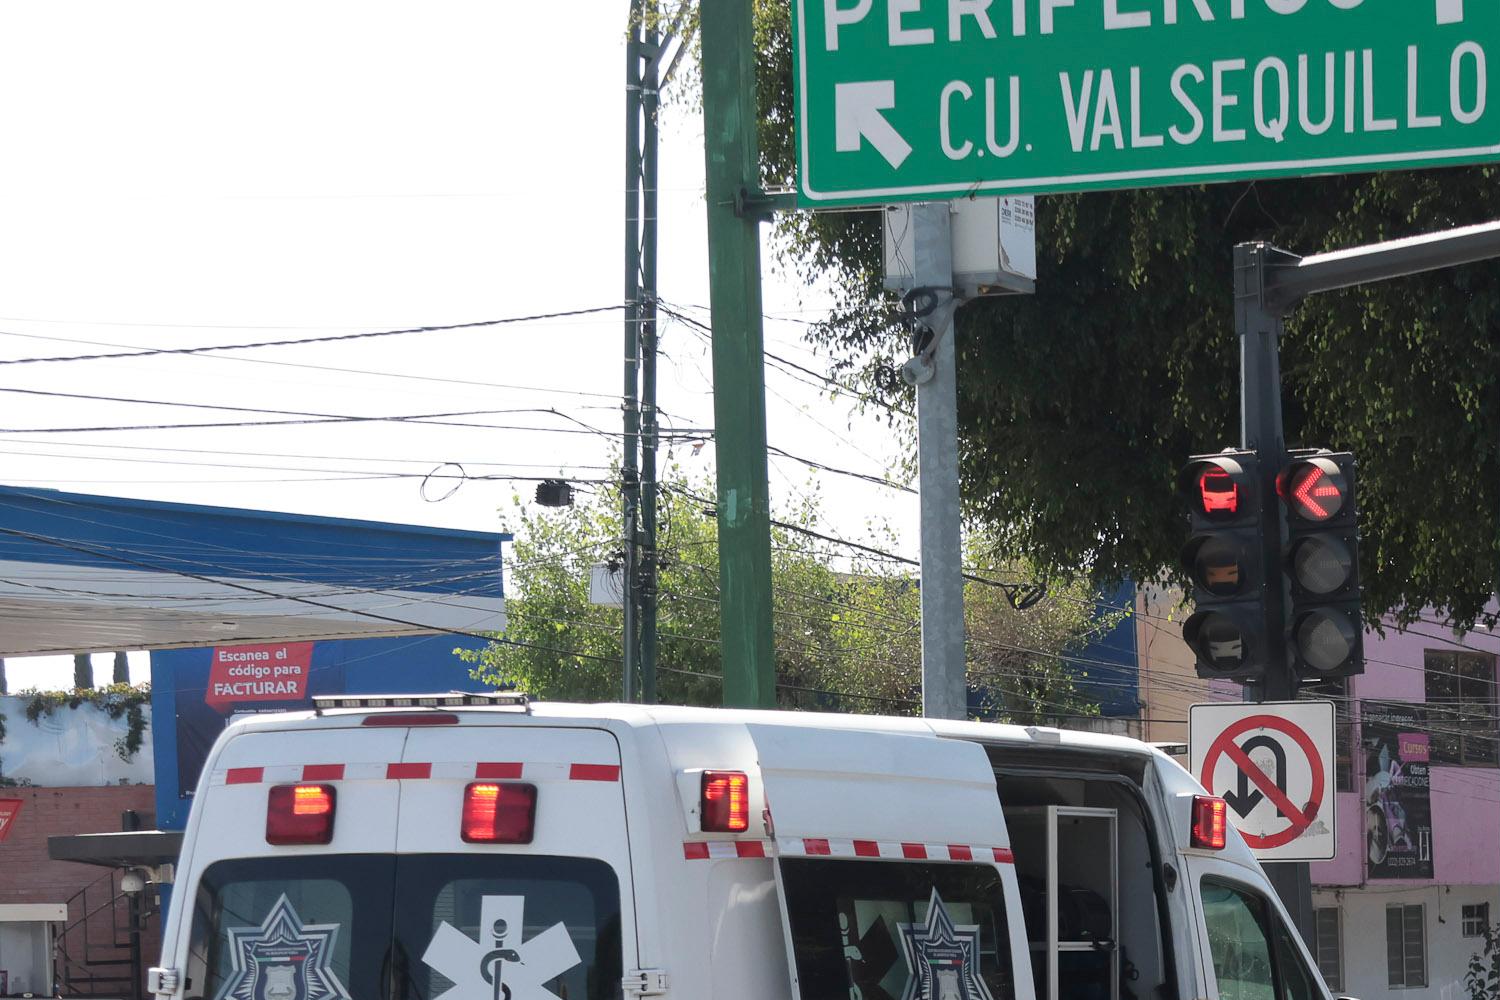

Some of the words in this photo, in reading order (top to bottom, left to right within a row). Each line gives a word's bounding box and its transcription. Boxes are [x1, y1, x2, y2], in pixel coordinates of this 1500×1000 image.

[940, 75, 1033, 160] C.U.
[1058, 40, 1487, 153] VALSEQUILLO
[219, 650, 270, 662] Escanea
[275, 648, 287, 660] el
[228, 665, 271, 679] código
[274, 665, 301, 677] para
[214, 680, 298, 696] FACTURAR
